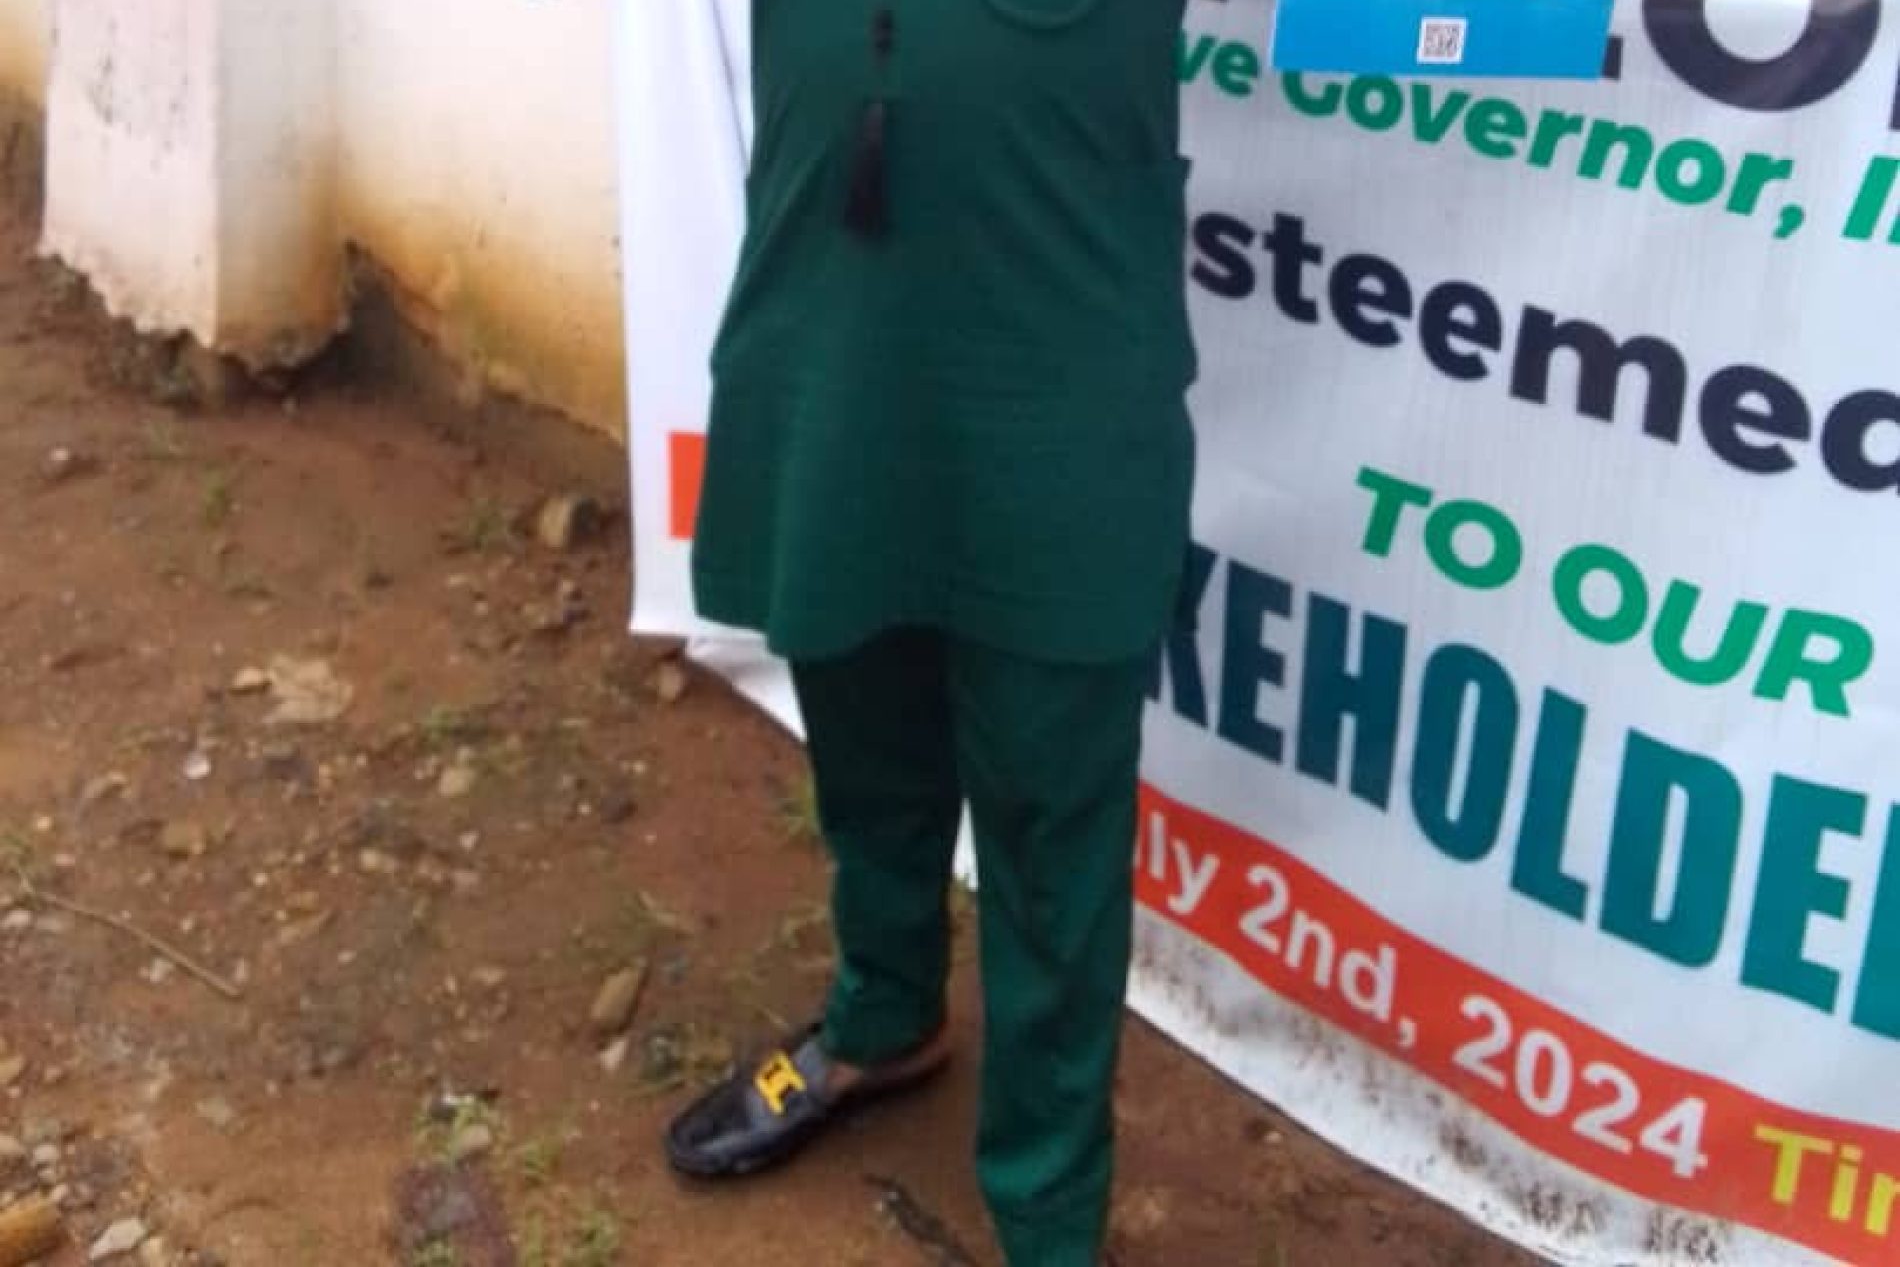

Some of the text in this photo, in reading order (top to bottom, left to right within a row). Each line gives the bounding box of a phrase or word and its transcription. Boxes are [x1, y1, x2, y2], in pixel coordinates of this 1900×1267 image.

[1356, 466, 1874, 718] TO OUR
[1238, 864, 1419, 1052] 2nd,
[1449, 994, 1709, 1181] 2024
